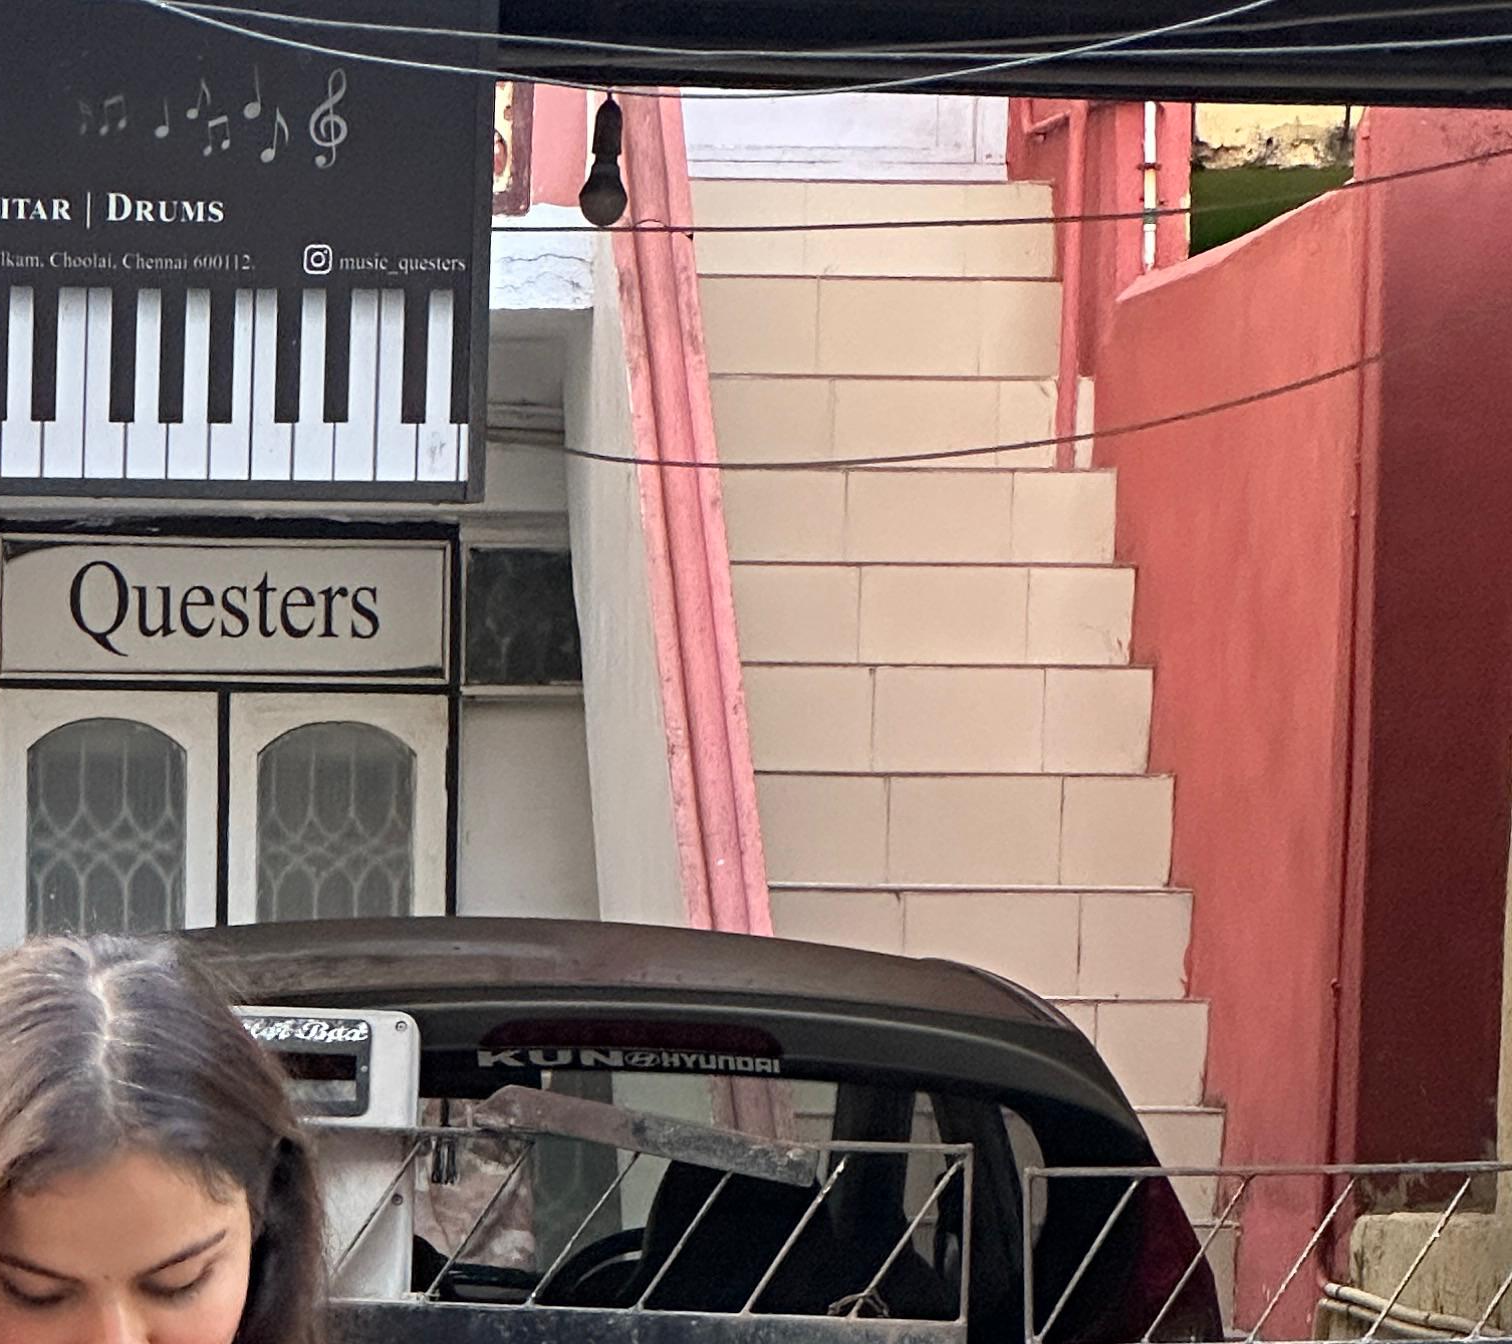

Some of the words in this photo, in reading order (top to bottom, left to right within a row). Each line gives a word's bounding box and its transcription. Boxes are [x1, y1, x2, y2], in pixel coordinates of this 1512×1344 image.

[106, 192, 225, 224] DRUMS
[122, 252, 188, 270] Chennai
[339, 253, 467, 276] music_questers
[69, 560, 380, 657] Questers
[478, 1050, 624, 1068] KUN
[659, 1051, 782, 1074] HYUNDAI
